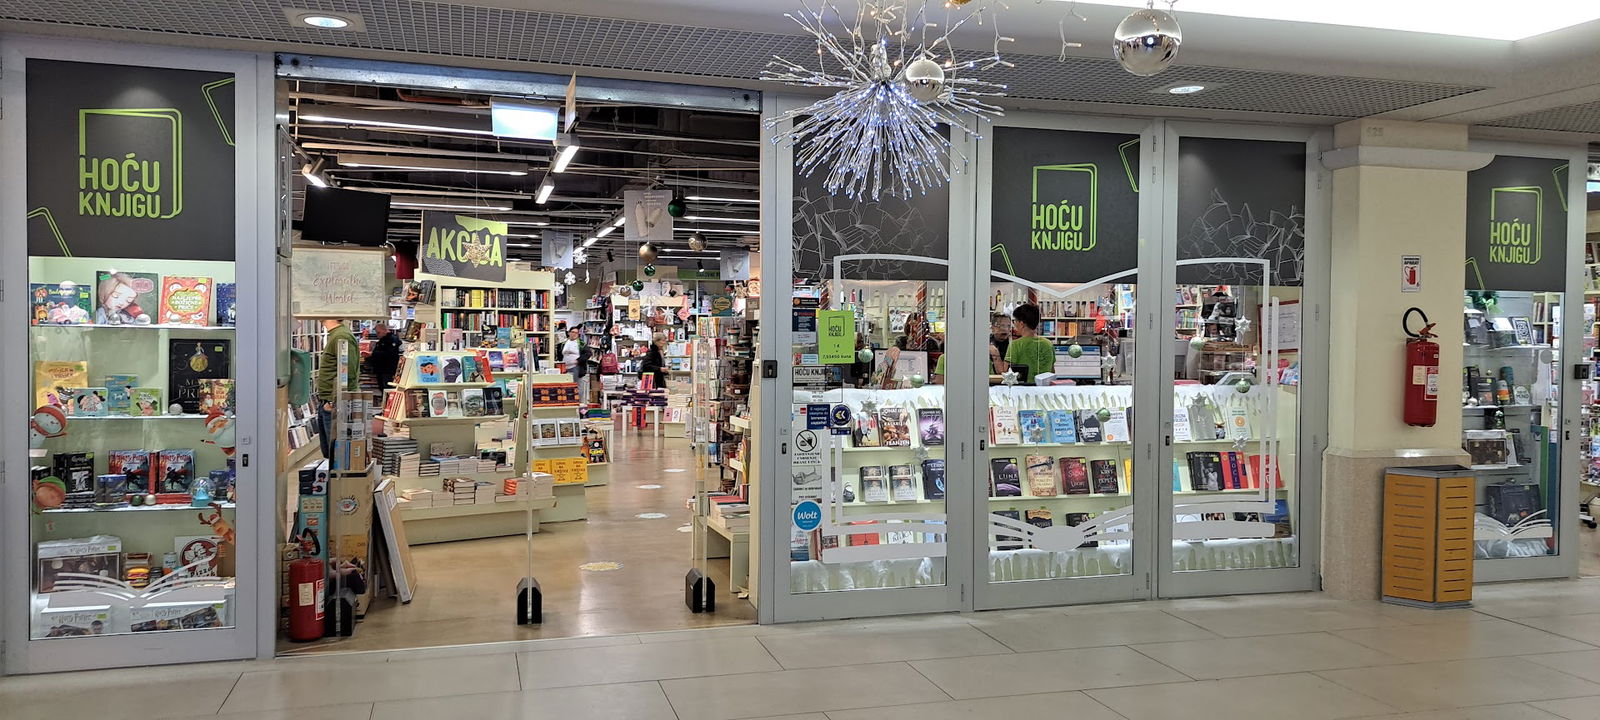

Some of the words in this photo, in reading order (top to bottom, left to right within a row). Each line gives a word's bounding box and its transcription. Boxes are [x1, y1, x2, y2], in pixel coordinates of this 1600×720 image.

[79, 152, 160, 192] HOĆU
[79, 191, 161, 218] KNJIGU
[1032, 199, 1083, 231] HOĆU
[1031, 231, 1083, 251] KNJIGU
[1490, 217, 1531, 247] HOĆU
[426, 226, 503, 268] AKCJA
[1489, 245, 1531, 264] KNJIGU
[797, 511, 818, 520] Wolt
